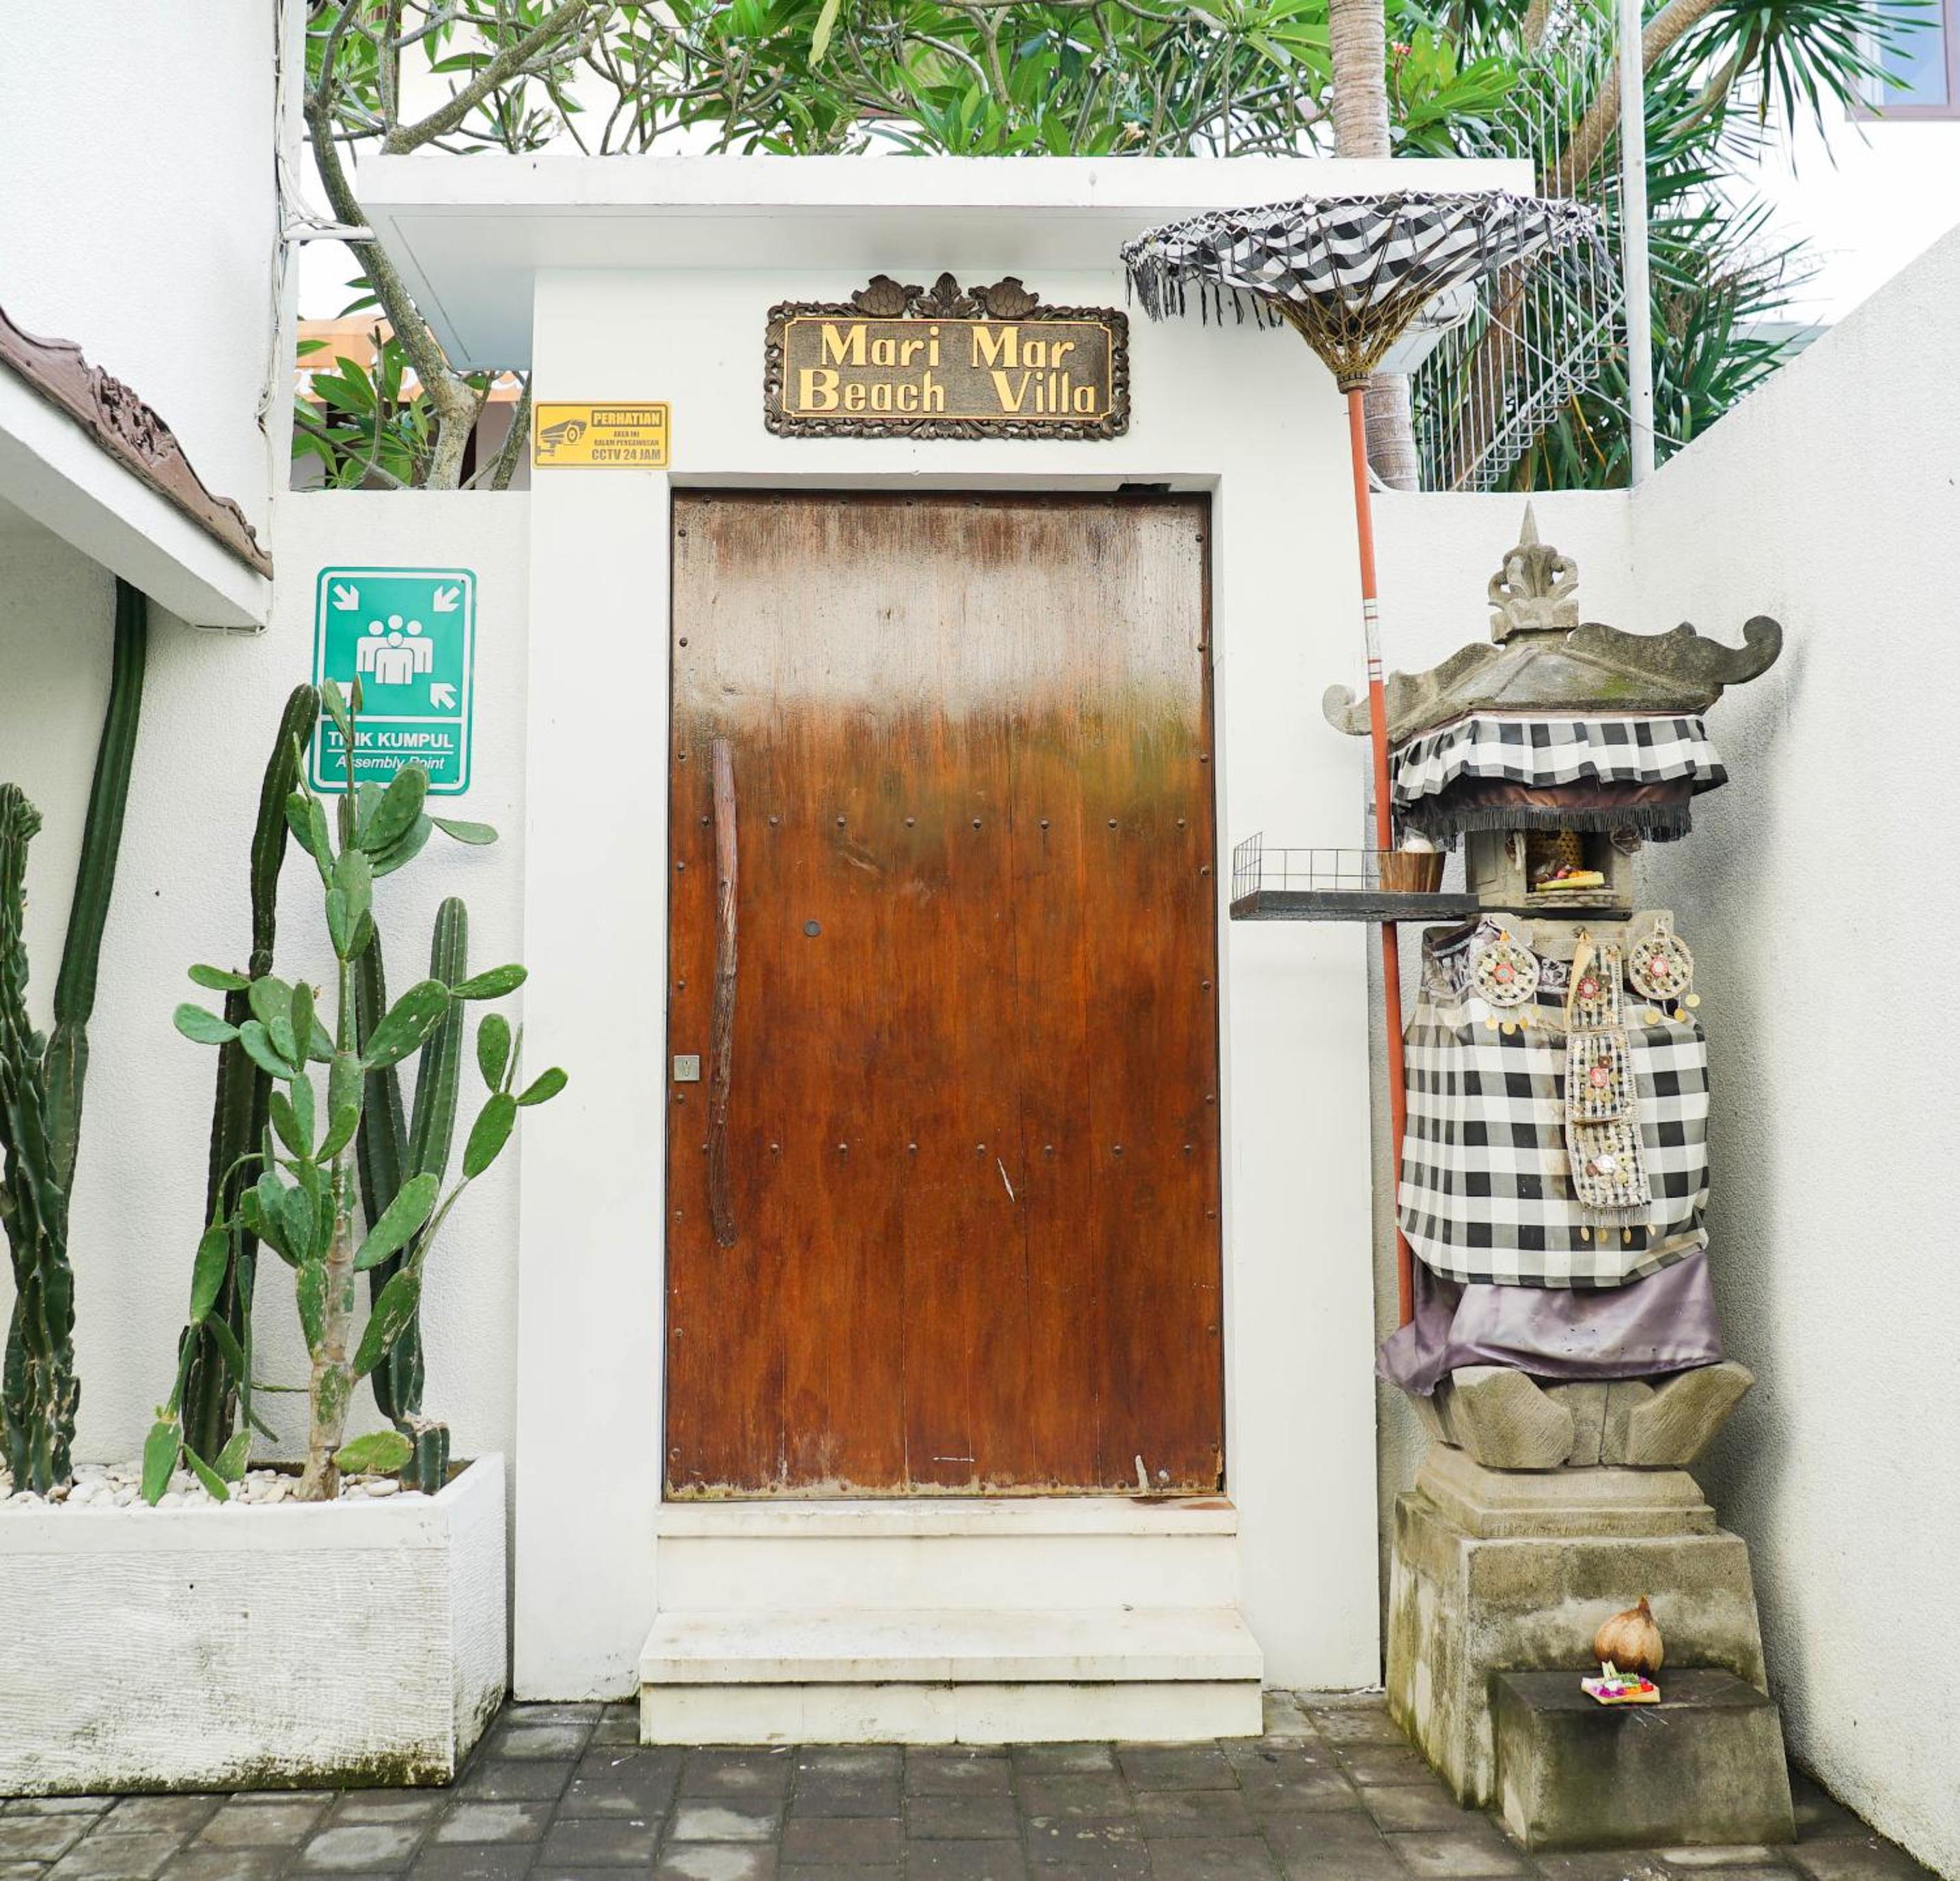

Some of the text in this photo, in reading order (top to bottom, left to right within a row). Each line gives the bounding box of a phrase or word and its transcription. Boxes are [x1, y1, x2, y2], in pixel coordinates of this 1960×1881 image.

[820, 323, 1075, 368] Mari Mar
[799, 369, 1095, 413] Beach Villa
[593, 412, 661, 424] PERHATIAN
[592, 449, 661, 460] CCTV 24 JAM
[328, 731, 454, 748] TIIK KUMPUL
[335, 755, 405, 771] Asembly
